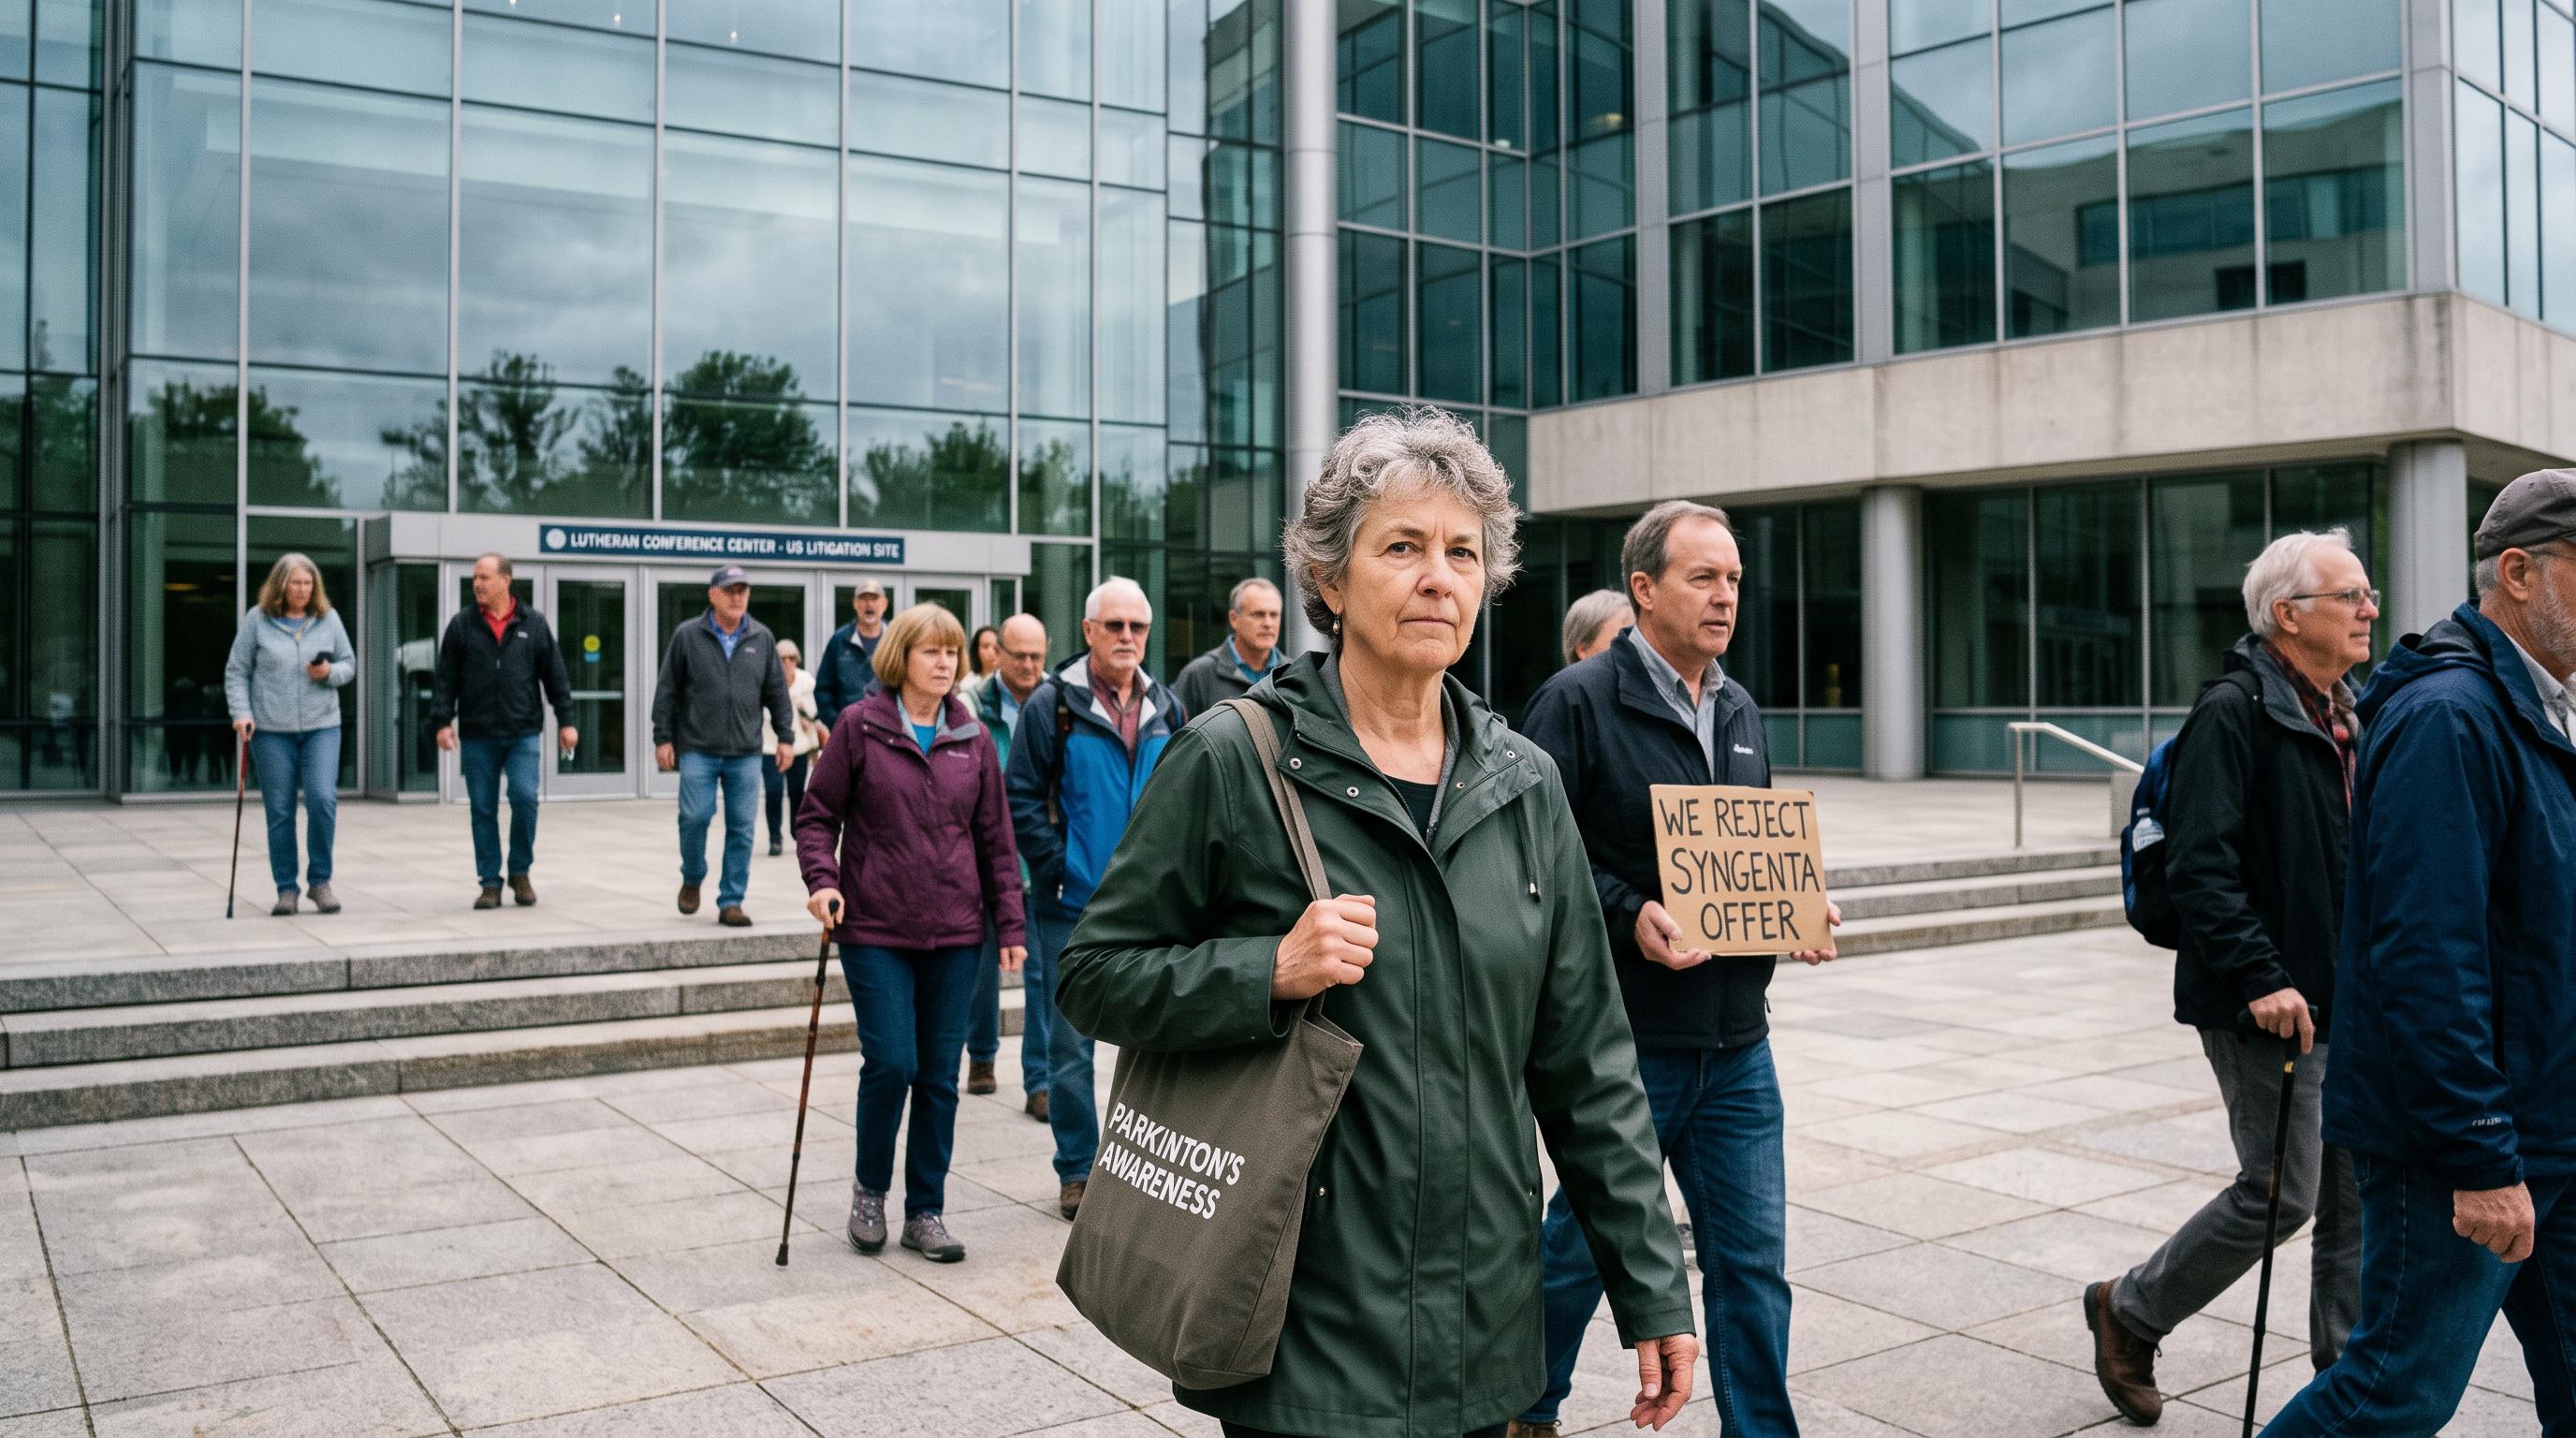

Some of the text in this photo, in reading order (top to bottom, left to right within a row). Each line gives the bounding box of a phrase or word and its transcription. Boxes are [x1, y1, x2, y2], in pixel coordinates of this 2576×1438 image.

[570, 533, 640, 549] LUTHERAN
[642, 535, 724, 552] CONFERENCE
[726, 537, 776, 553] CENTER
[785, 539, 804, 554] US
[806, 540, 871, 557] LITIGATION
[872, 543, 900, 558] SITE
[1659, 798, 1810, 840] WE REJECT
[1671, 847, 1821, 895] SYNGENTA
[1700, 900, 1801, 941] OFFER
[1108, 1102, 1246, 1186] PARKINTON'S
[1097, 1140, 1222, 1220] AWARENESS
